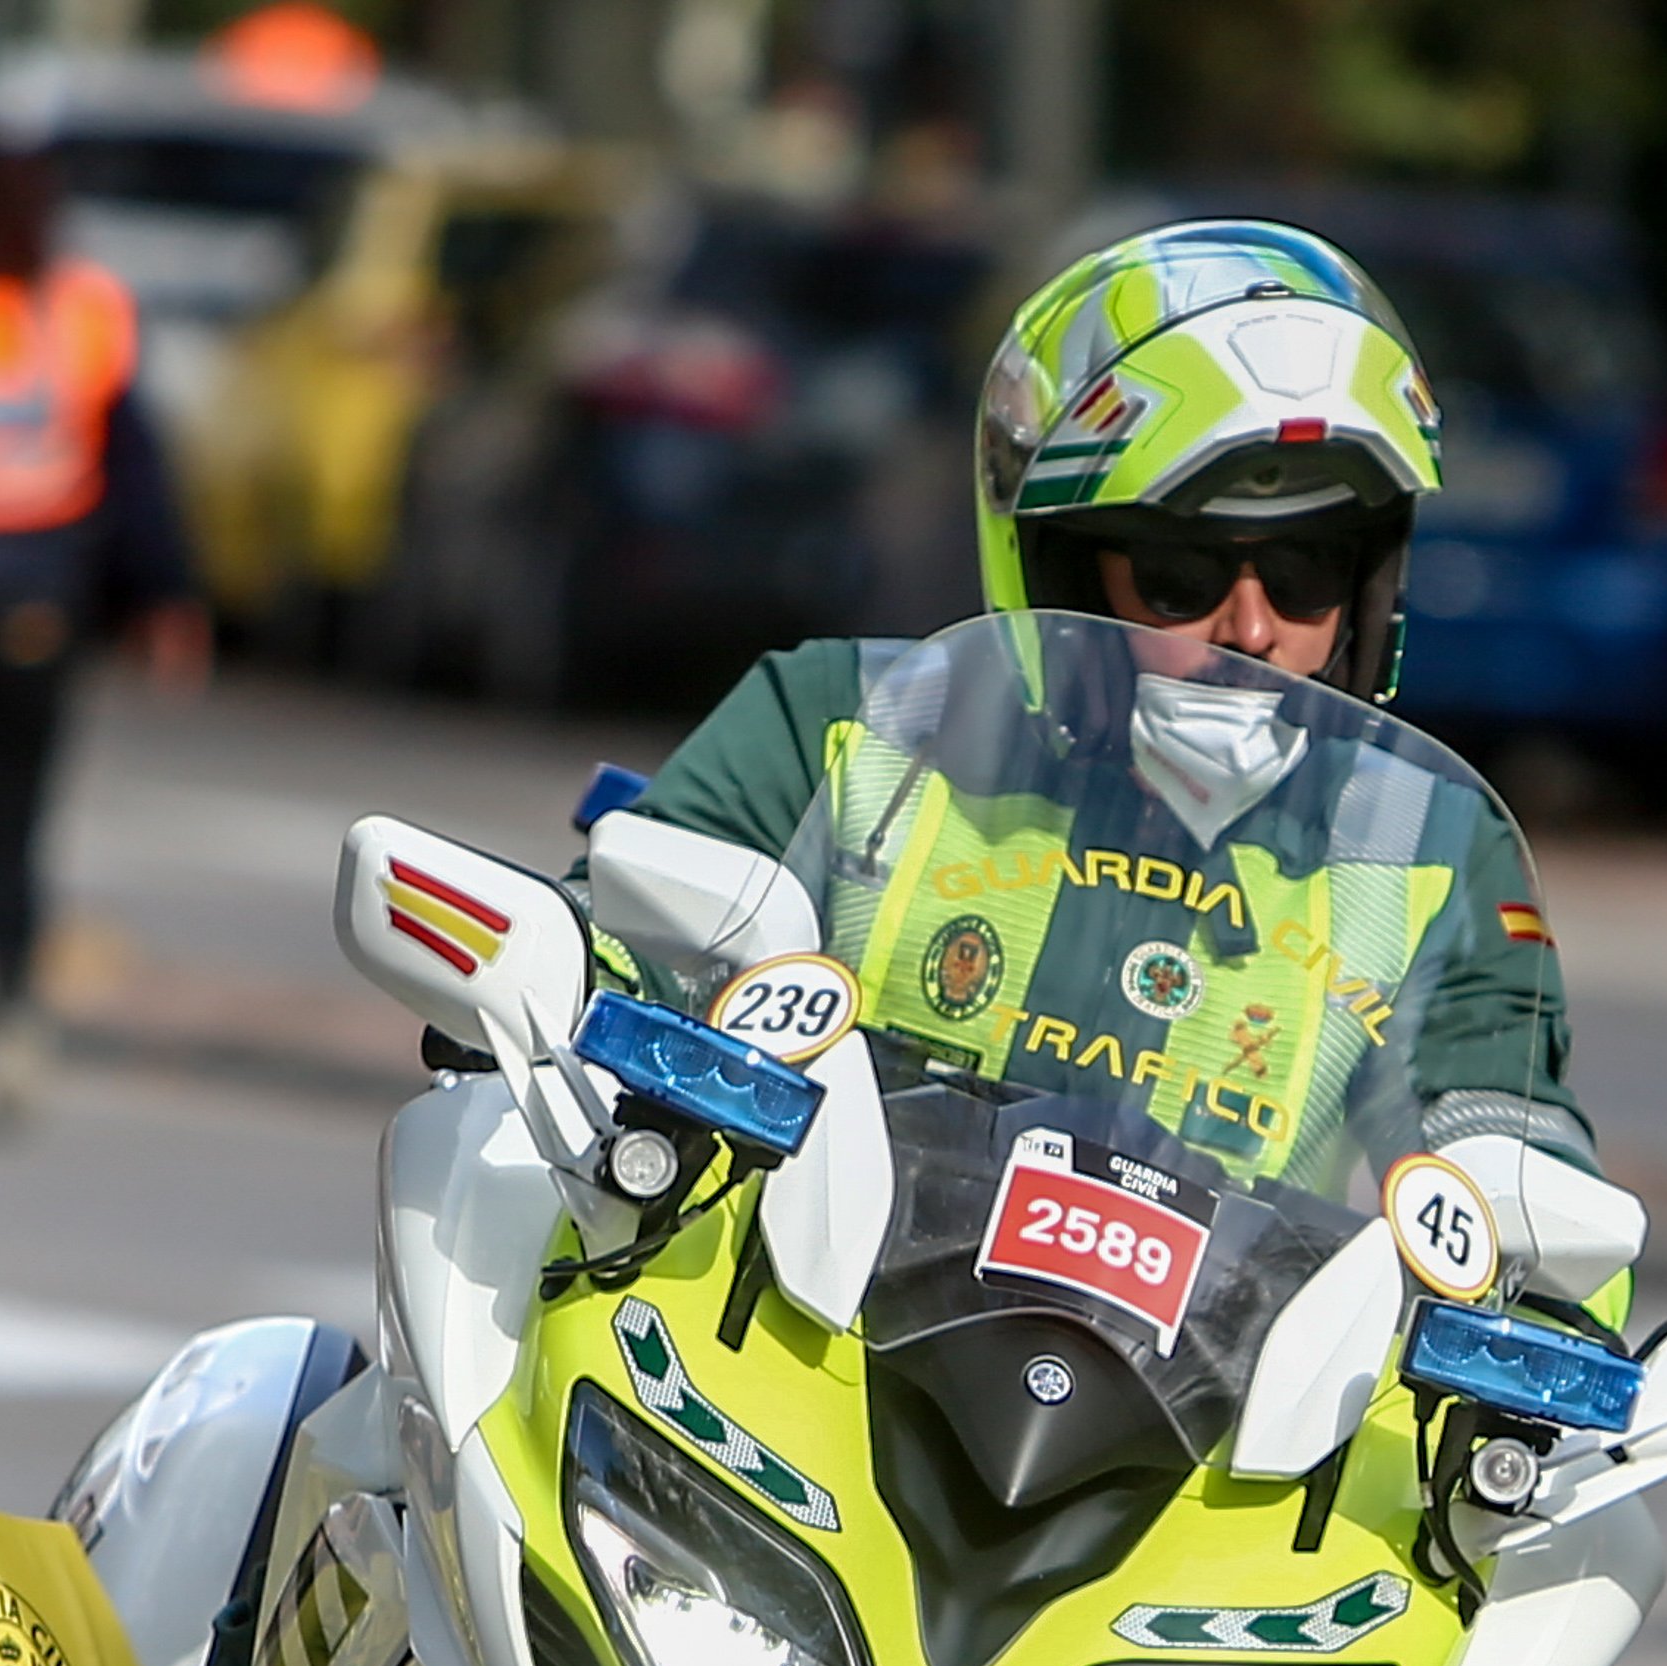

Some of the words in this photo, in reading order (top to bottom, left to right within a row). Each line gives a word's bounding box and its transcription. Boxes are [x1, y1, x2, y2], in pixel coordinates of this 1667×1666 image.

[933, 848, 1245, 928] GUARDIA
[1270, 919, 1394, 1047] CIVIL
[726, 982, 841, 1037] 239
[987, 1005, 1291, 1142] TRAFICO
[1109, 1156, 1177, 1196] GUARDIA
[1120, 1174, 1160, 1201] CIVIL
[1019, 1198, 1172, 1286] 2589
[1417, 1192, 1474, 1267] 45
